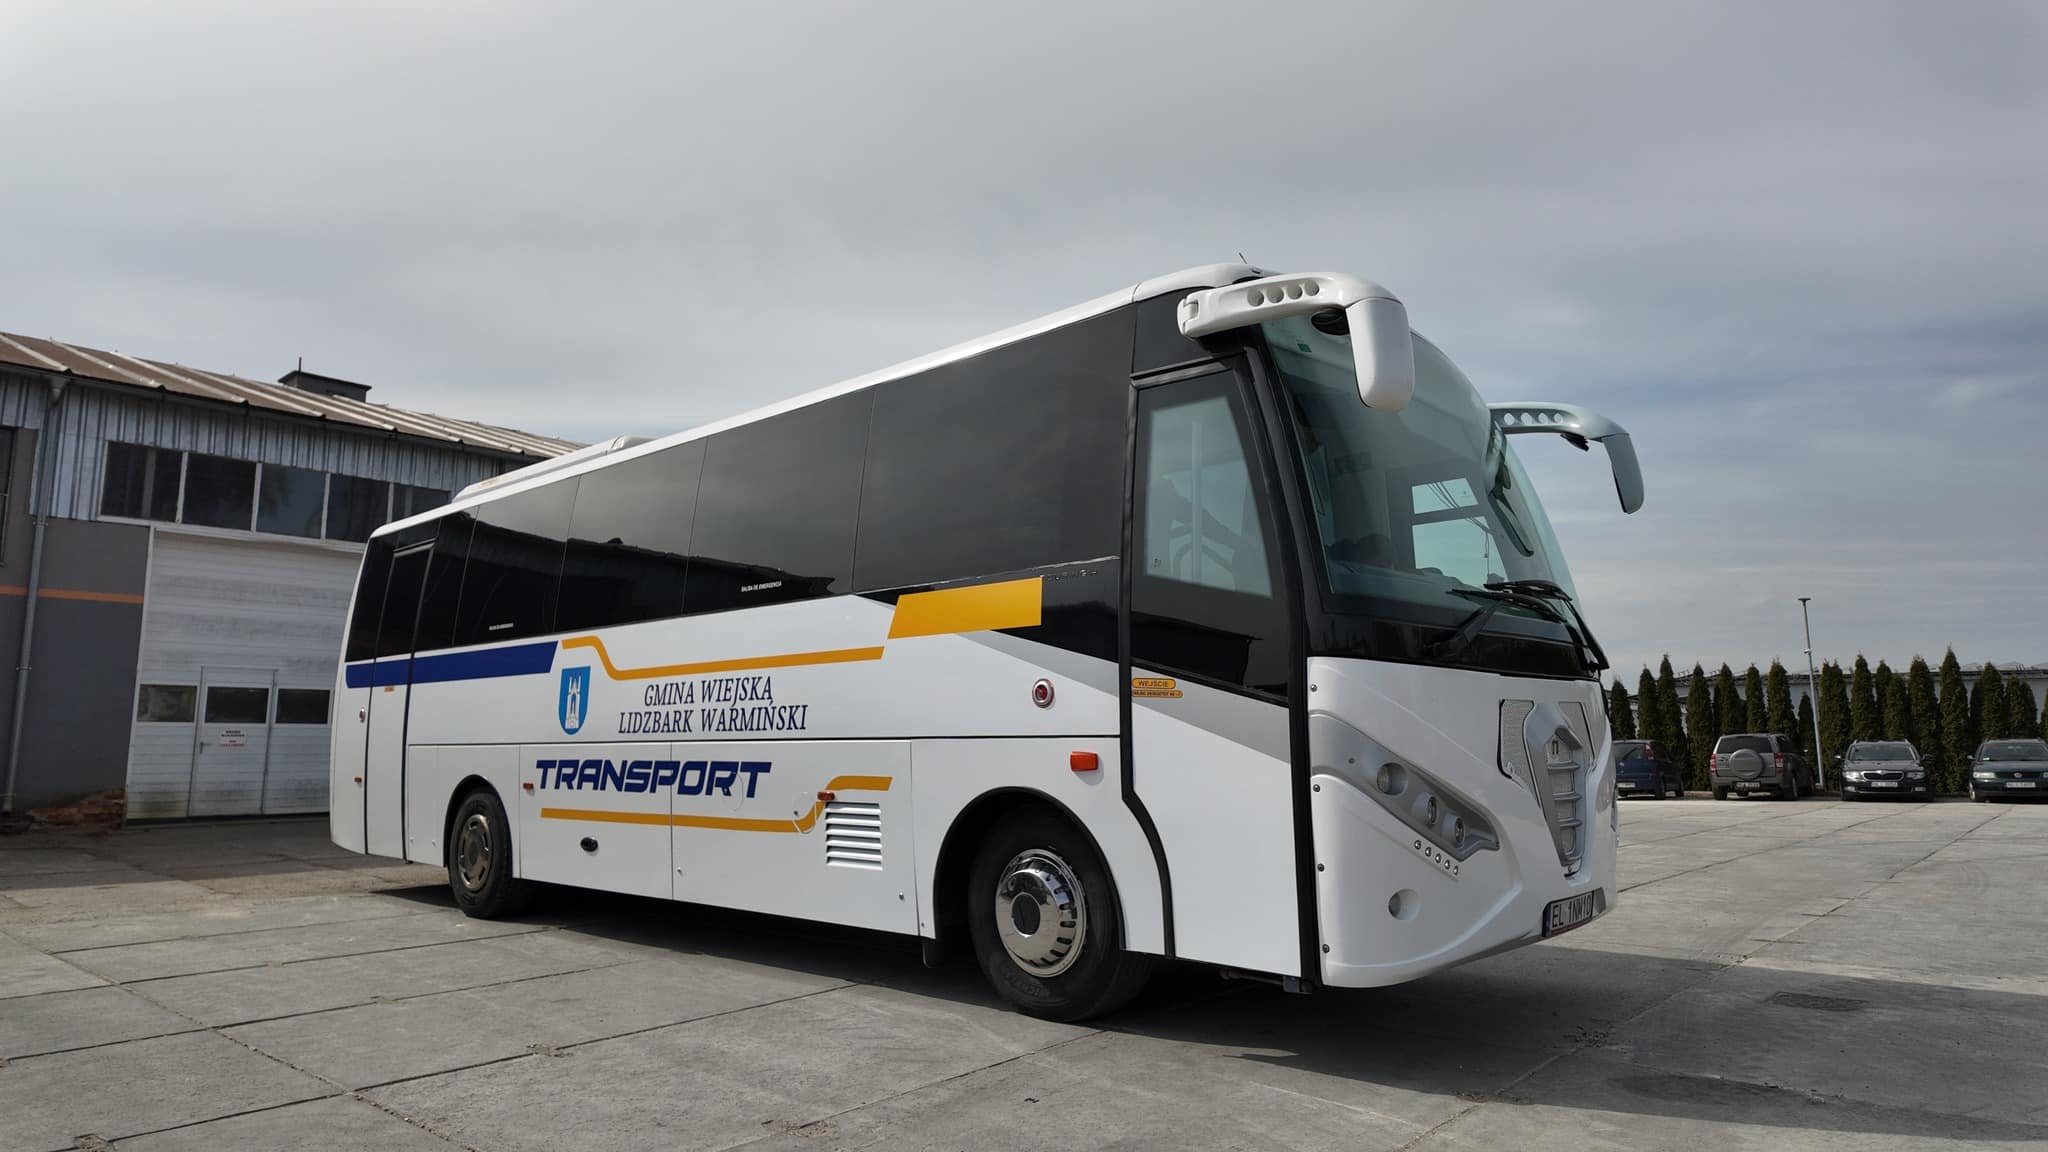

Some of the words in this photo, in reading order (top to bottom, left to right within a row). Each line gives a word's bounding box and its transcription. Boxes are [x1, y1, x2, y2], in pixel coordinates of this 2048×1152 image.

[644, 681, 695, 706] GMINA
[701, 676, 774, 707] WIEJSKĄ
[618, 710, 694, 733] LIDZBARK
[701, 703, 808, 732] WARMIŃSKI
[536, 760, 772, 798] TRANSPORT
[1552, 903, 1564, 927] EL
